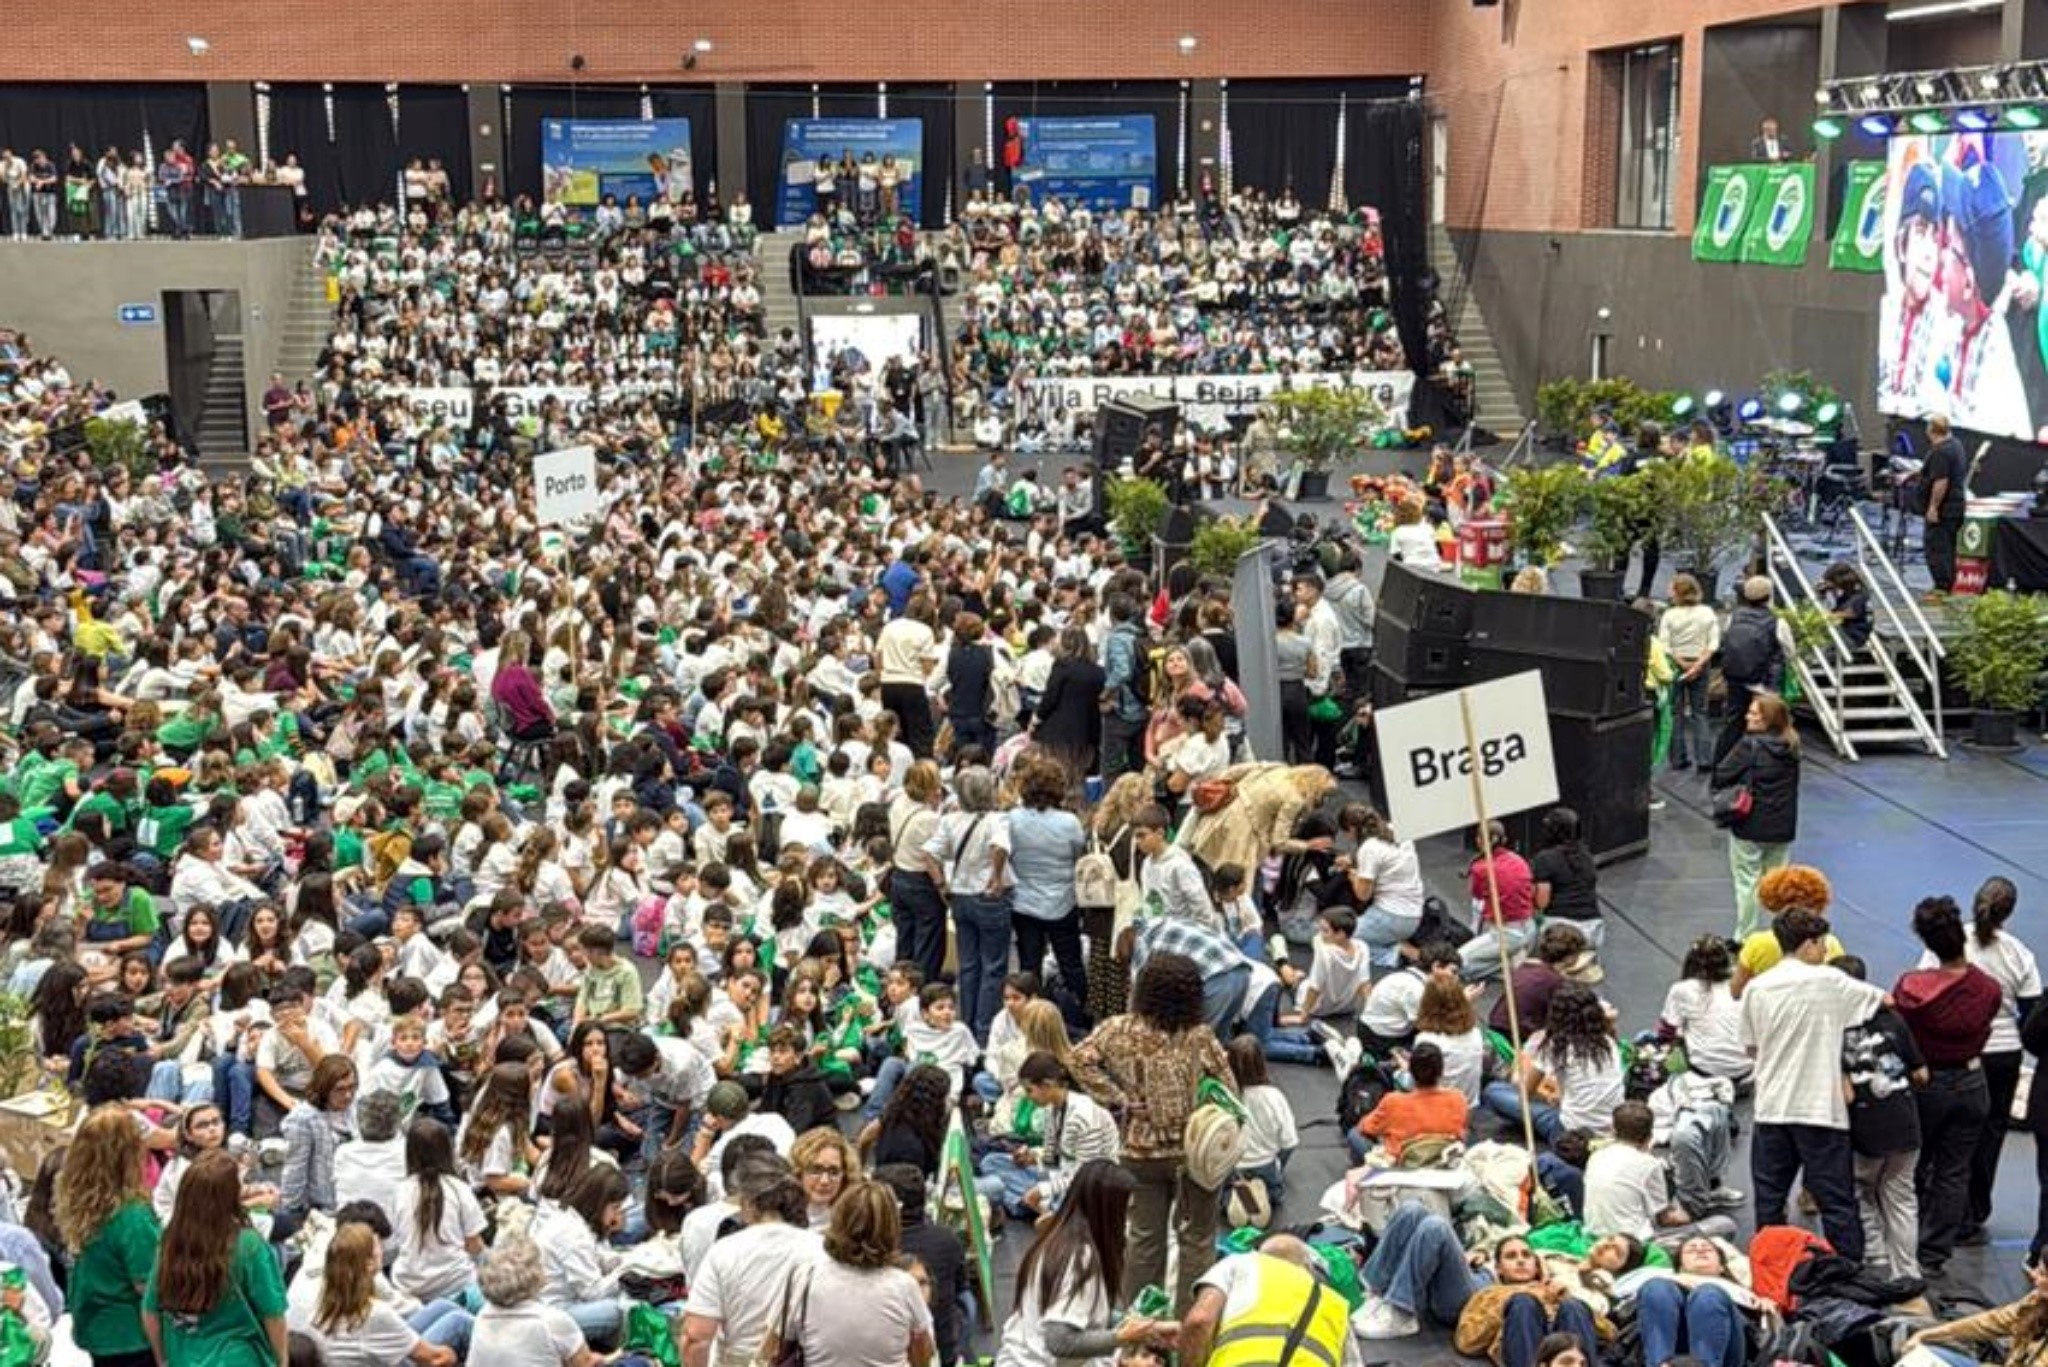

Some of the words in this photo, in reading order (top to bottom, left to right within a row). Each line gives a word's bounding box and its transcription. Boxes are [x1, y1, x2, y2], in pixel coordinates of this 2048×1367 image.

[1197, 380, 1261, 409] Beja
[545, 473, 587, 497] Porto
[1408, 731, 1527, 788] Braga
